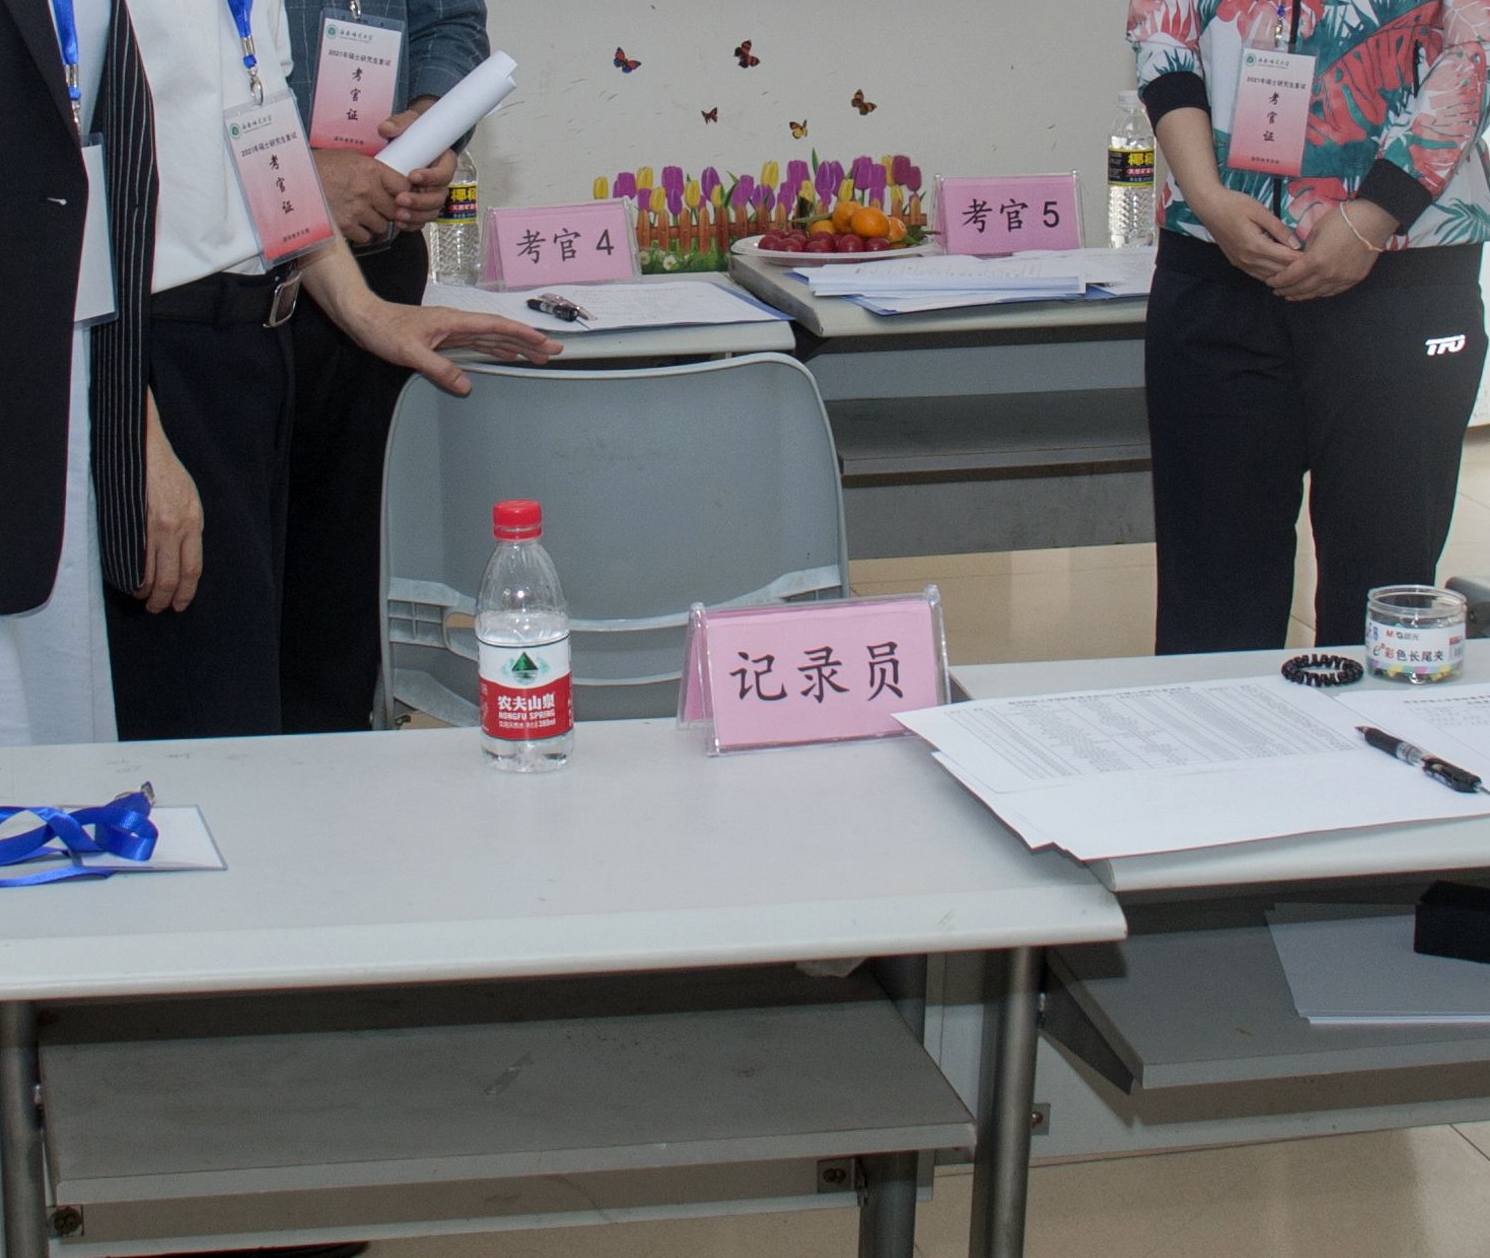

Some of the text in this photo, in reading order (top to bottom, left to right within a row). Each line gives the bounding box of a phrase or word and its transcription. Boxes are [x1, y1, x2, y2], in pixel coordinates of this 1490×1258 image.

[346, 67, 363, 121] 考官证
[1263, 91, 1280, 142] 考官证
[269, 154, 294, 214] 考官证
[729, 641, 904, 705] 记录员
[498, 693, 555, 711] 农夫山泉
